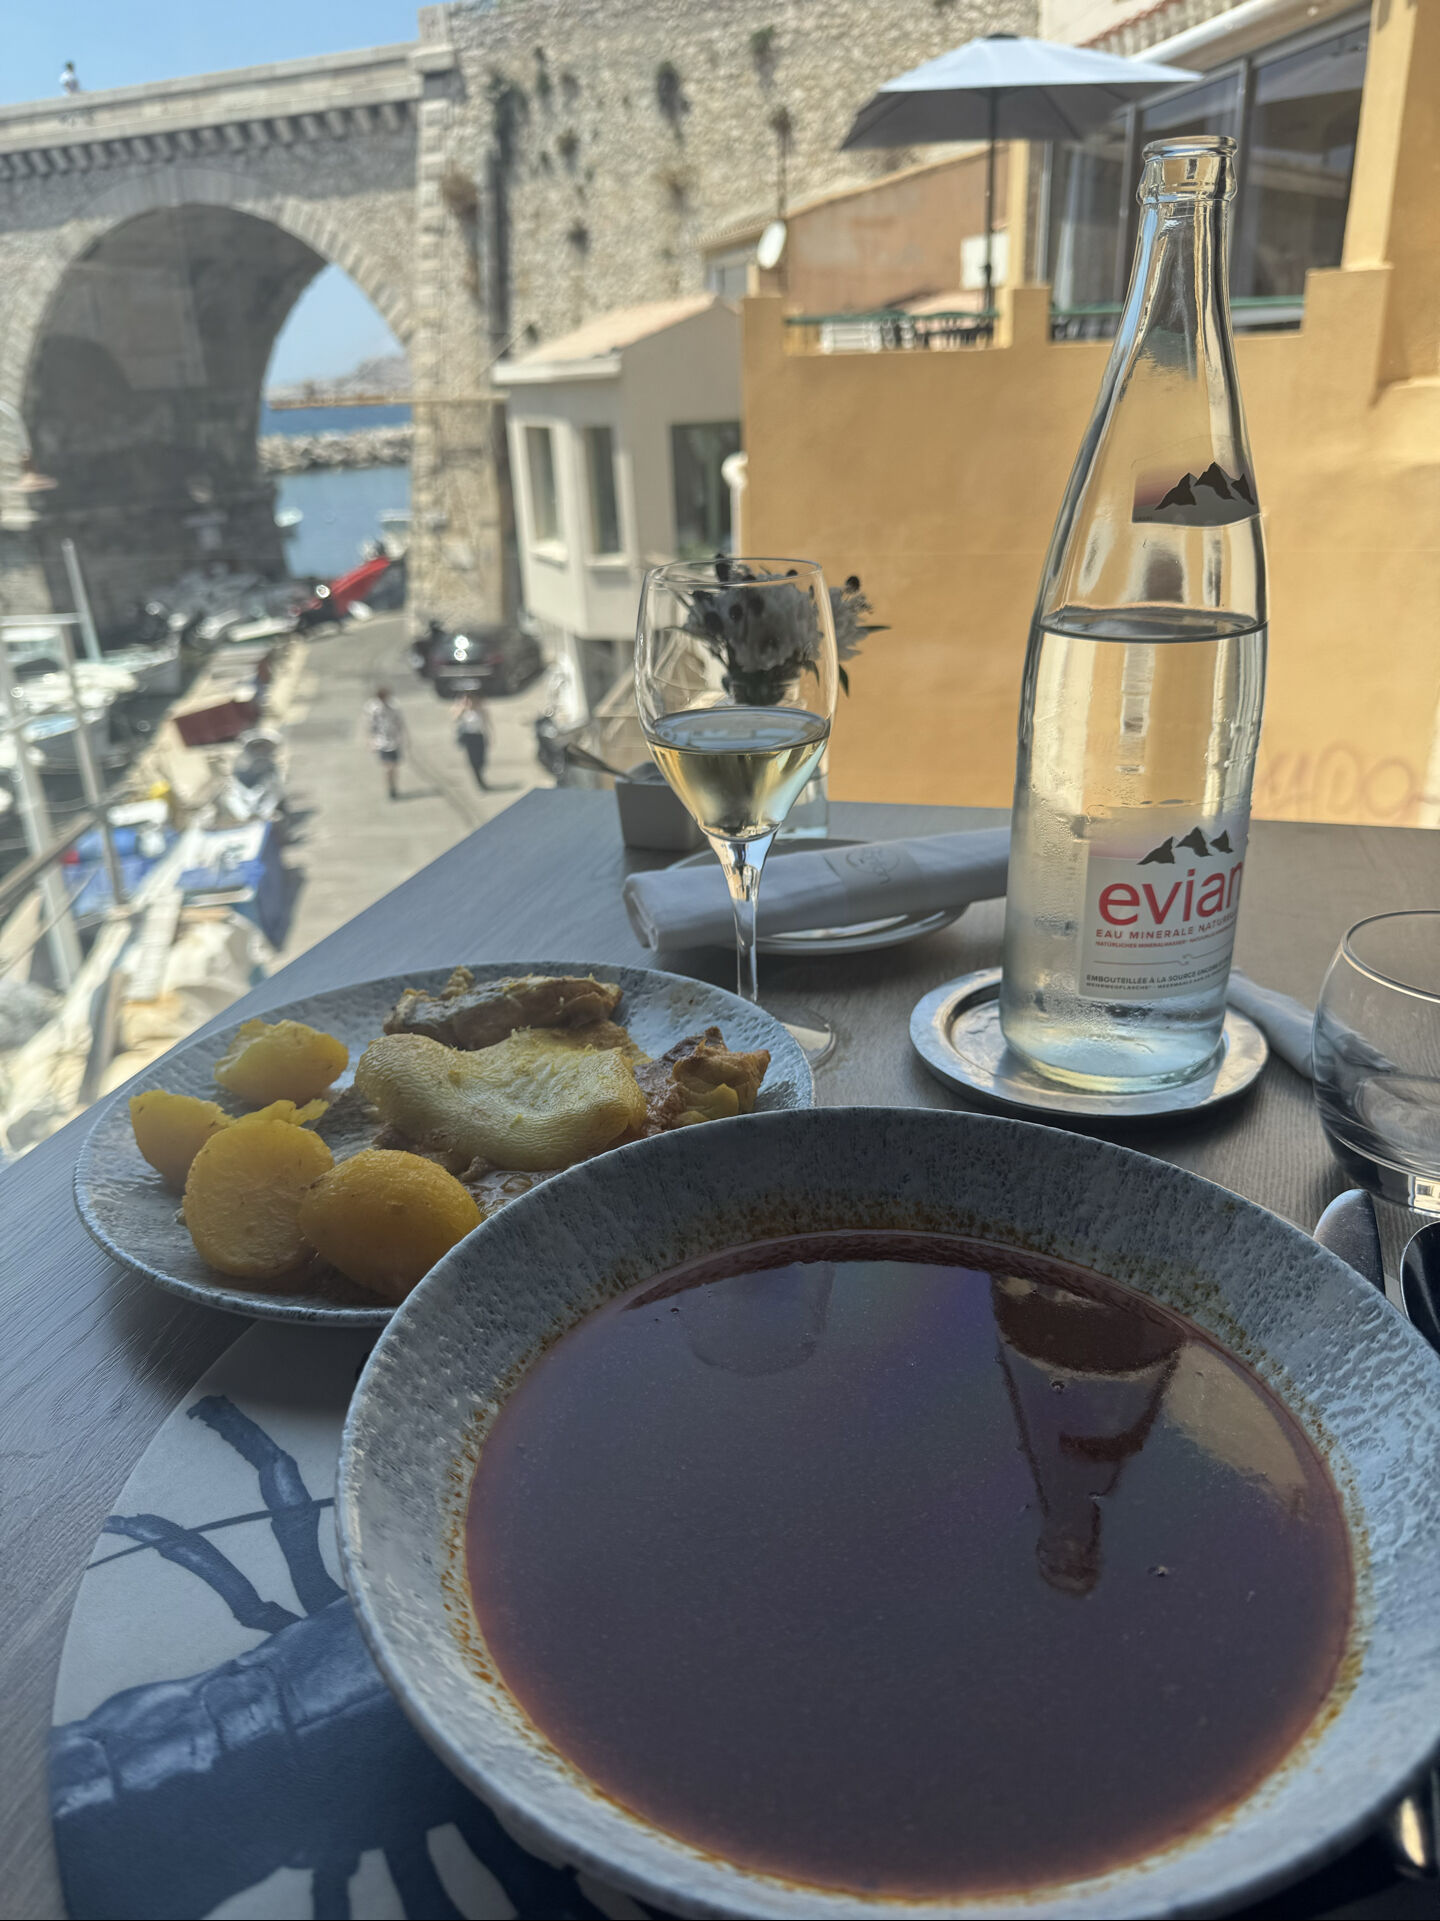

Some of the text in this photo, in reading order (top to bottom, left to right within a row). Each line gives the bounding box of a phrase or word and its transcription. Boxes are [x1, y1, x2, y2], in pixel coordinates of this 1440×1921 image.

[1098, 861, 1243, 927] evian
[1095, 929, 1123, 939] EAU
[1129, 926, 1194, 940] MINERALE
[1157, 974, 1167, 984] LA
[1168, 970, 1197, 983] SOURCE
